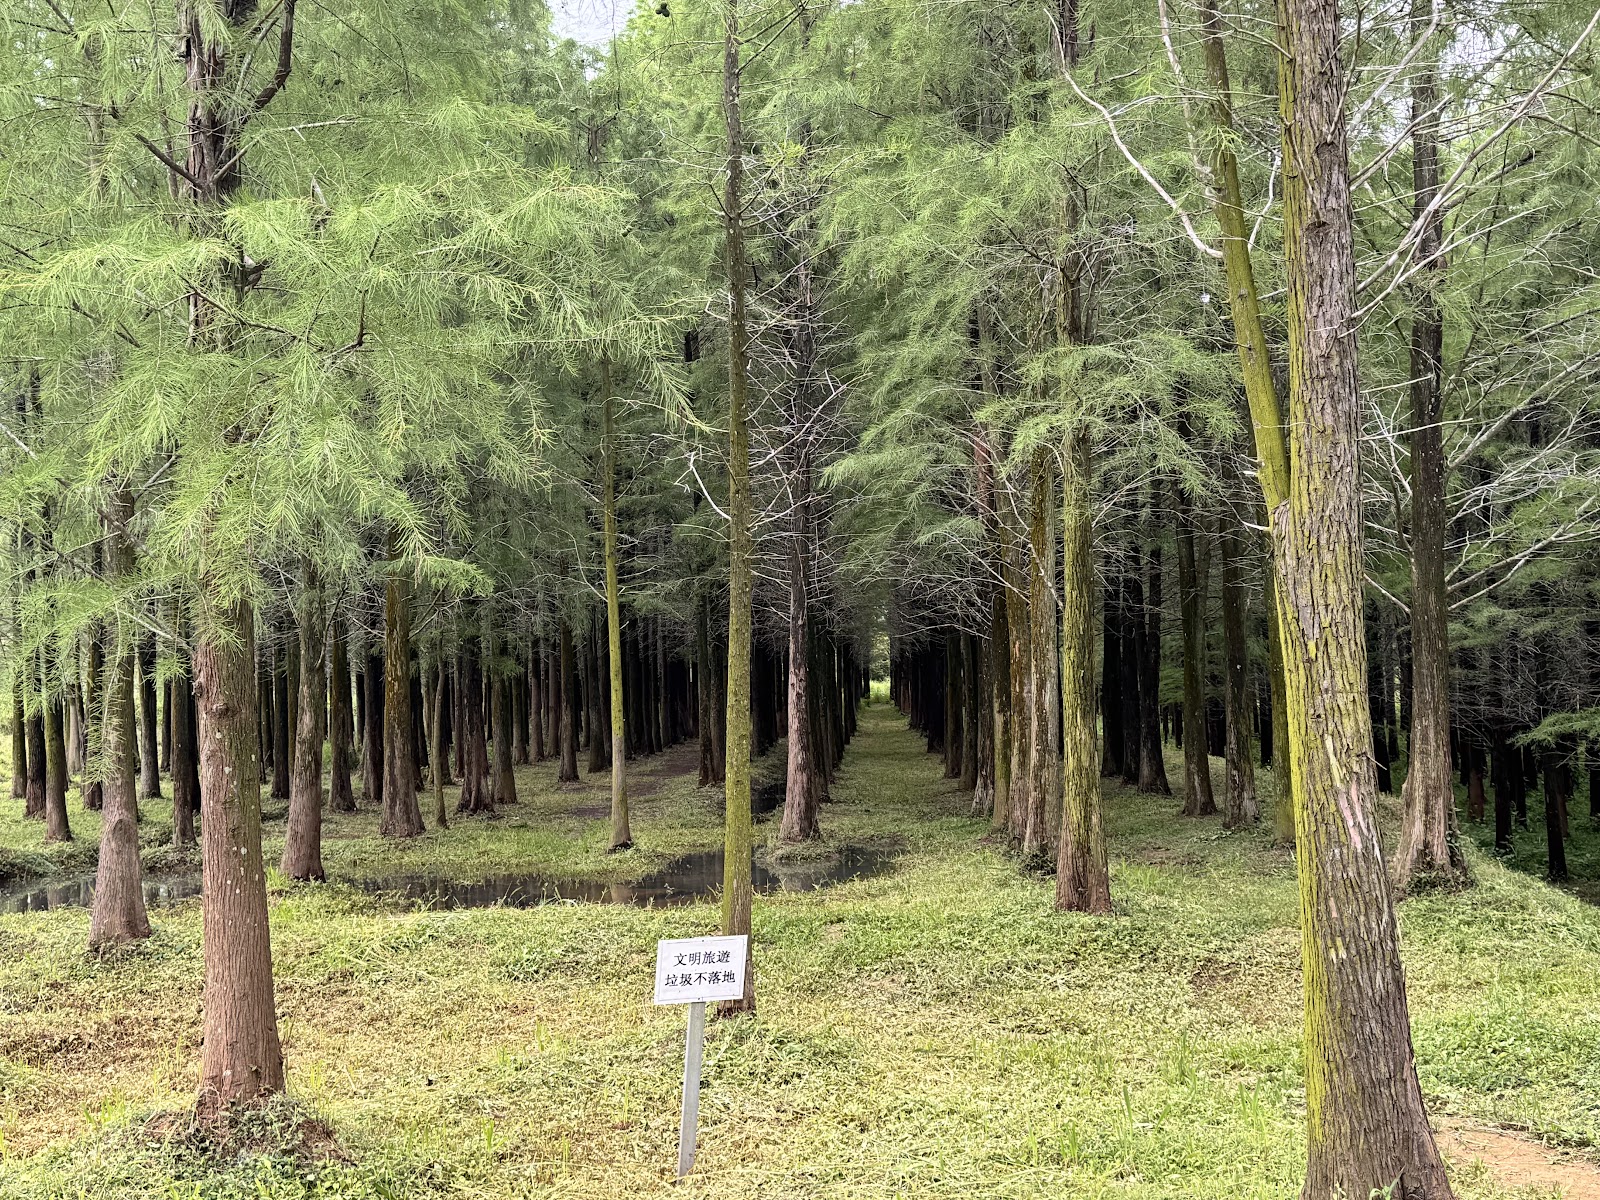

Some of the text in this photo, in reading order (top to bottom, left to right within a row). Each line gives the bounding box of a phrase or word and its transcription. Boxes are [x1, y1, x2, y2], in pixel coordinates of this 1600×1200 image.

[673, 950, 731, 967] 文明旅遊
[664, 970, 736, 987] 垃圾不落地
